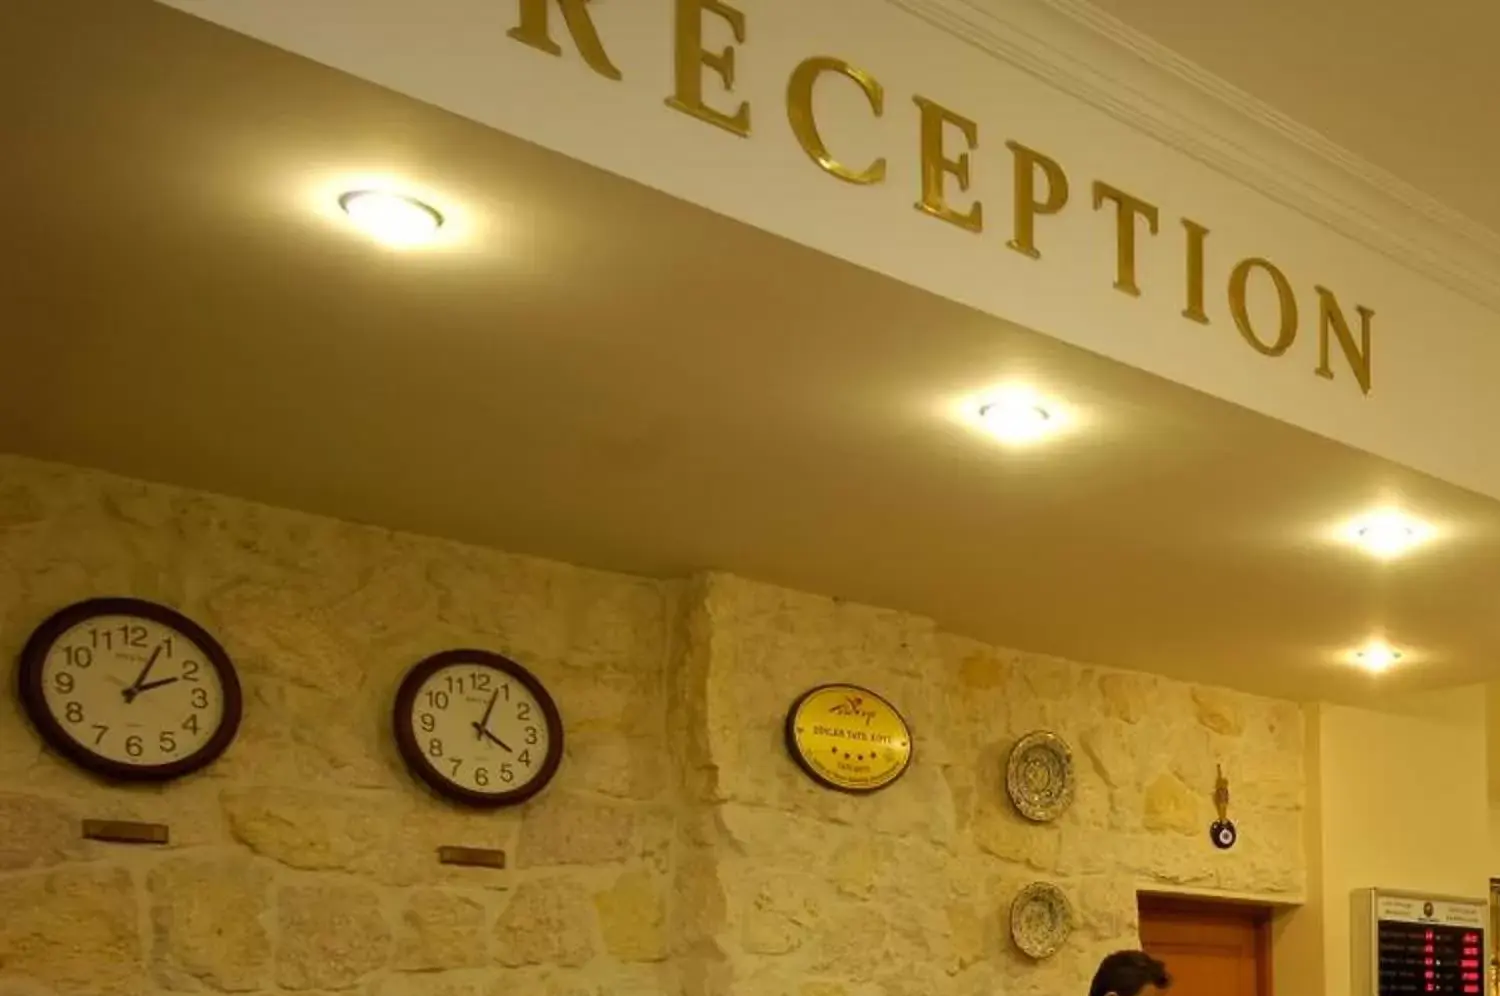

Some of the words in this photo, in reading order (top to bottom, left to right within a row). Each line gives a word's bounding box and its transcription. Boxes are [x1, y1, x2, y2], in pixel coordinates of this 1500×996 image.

[88, 628, 113, 651] 11
[117, 624, 148, 648] 12
[62, 645, 92, 669] 10
[163, 636, 173, 658] 1
[182, 659, 199, 682] 2
[54, 672, 74, 694] 9
[445, 676, 464, 695] 11
[469, 672, 492, 693] 12
[501, 683, 510, 701] 1
[191, 687, 209, 710] 3
[425, 690, 449, 710] 10
[65, 701, 84, 724] 8
[516, 701, 531, 721] 2
[182, 713, 199, 736] 4
[420, 713, 435, 732] 9
[91, 724, 109, 745] 7
[159, 731, 177, 753] 5
[525, 725, 538, 745] 3
[125, 735, 143, 757] 6
[428, 738, 443, 757] 8
[449, 758, 463, 777] 7
[517, 749, 531, 768] 4
[474, 767, 488, 786] 6
[500, 763, 514, 783] 5
